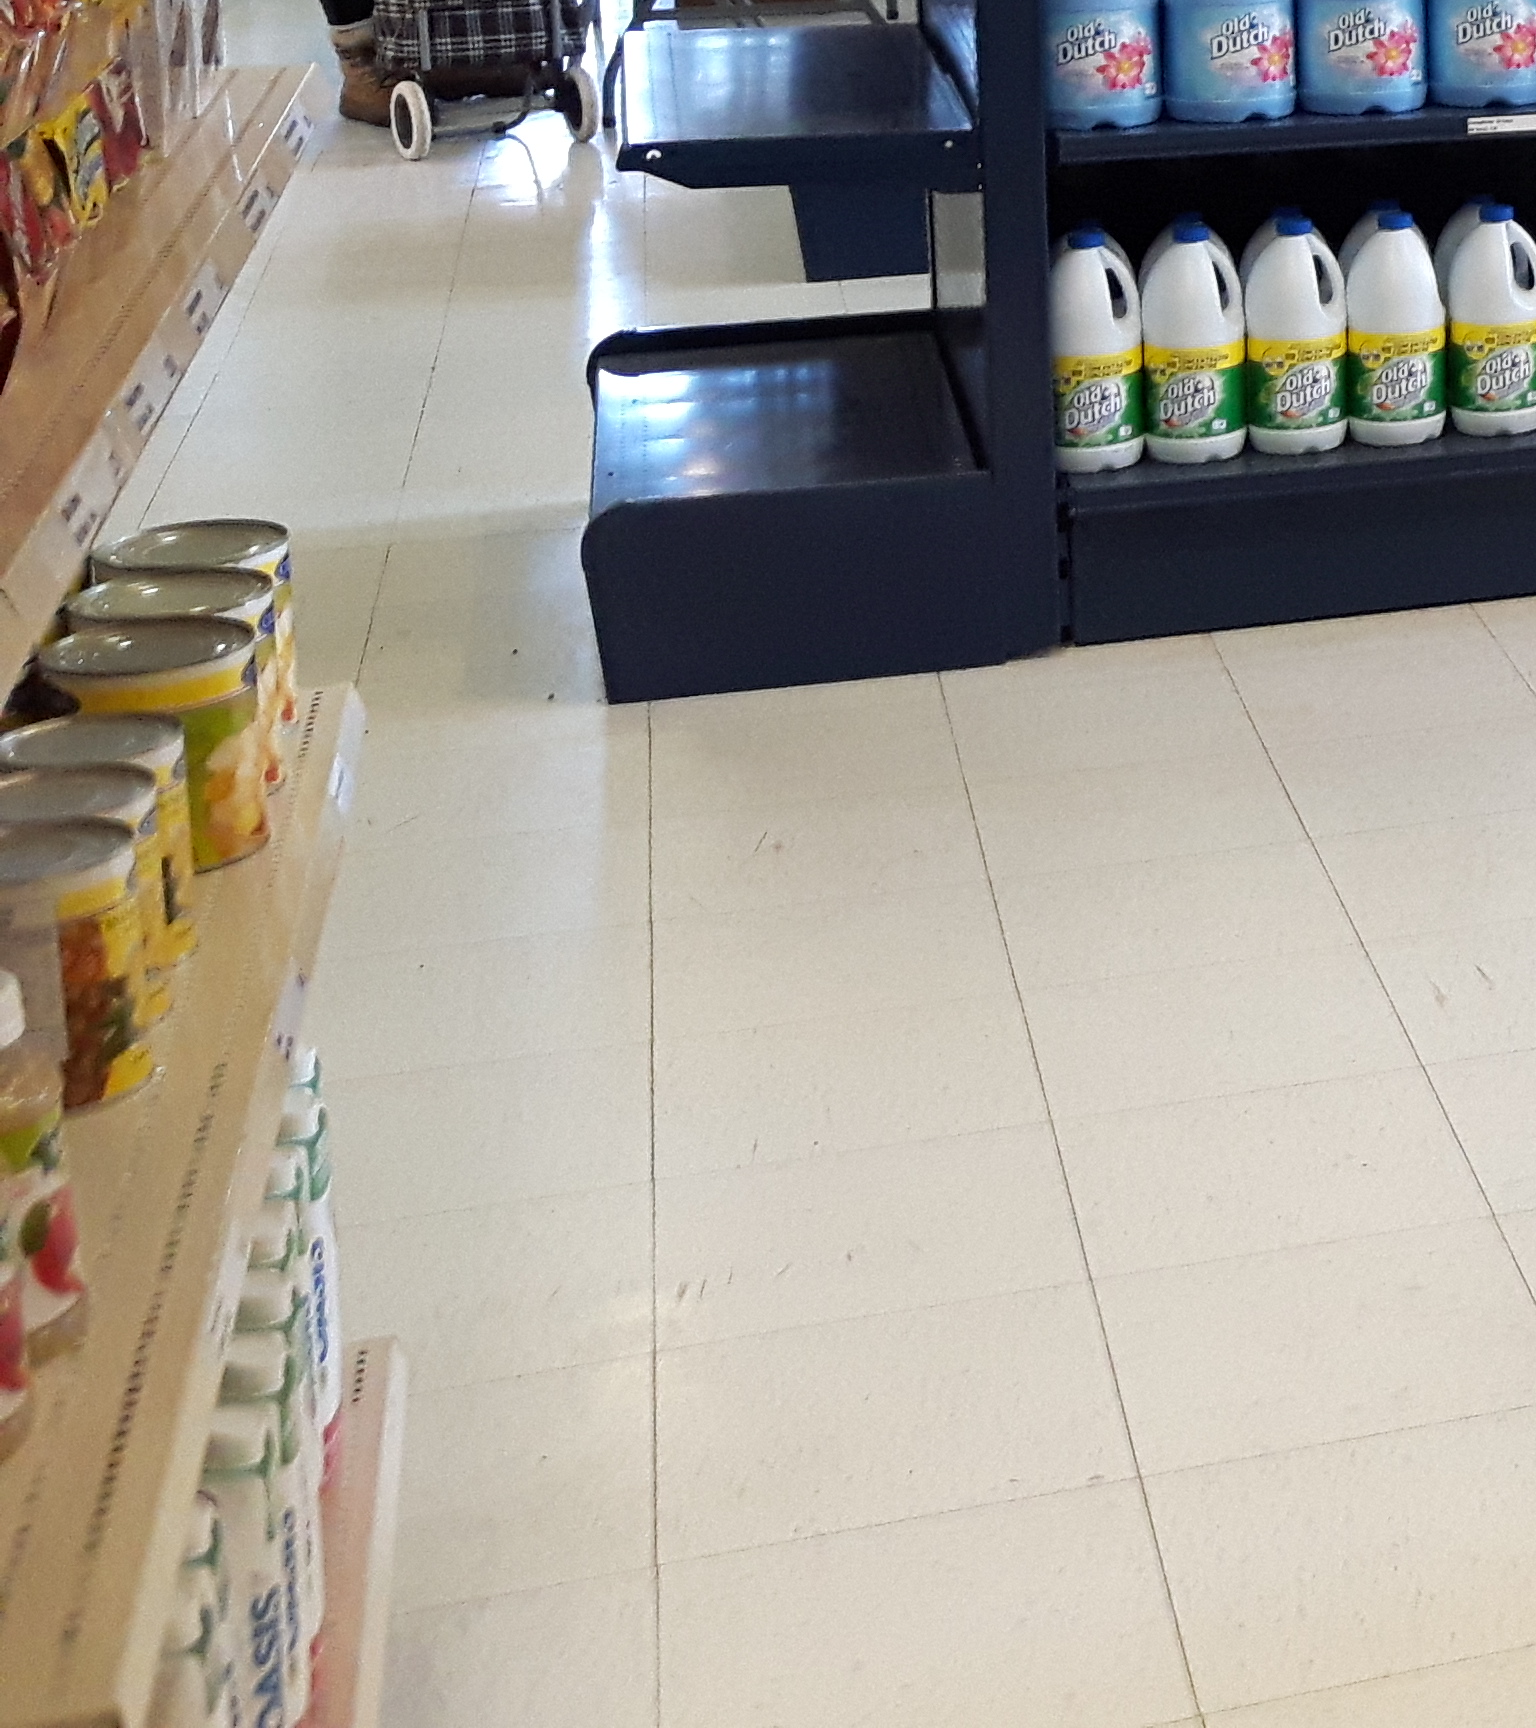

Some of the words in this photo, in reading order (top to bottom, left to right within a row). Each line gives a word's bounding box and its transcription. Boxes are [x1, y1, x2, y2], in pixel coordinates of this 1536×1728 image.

[1220, 15, 1252, 37] Old
[1338, 8, 1369, 30] Old
[1466, 2, 1497, 23] Old
[1065, 22, 1098, 43] Old
[1328, 18, 1387, 52] Dutch
[1456, 12, 1514, 45] Dutch
[1056, 31, 1117, 65] Dutch
[1210, 25, 1269, 61] Dutch
[1380, 363, 1412, 384] Old
[1484, 352, 1513, 374] Old
[1167, 377, 1197, 400] Old
[1284, 369, 1316, 391] Old
[1371, 372, 1428, 405] Dutch
[1476, 361, 1531, 394] Dutch
[1074, 387, 1102, 408] Old
[1158, 385, 1217, 420] Dutch
[1275, 378, 1331, 413] Dutch
[1064, 395, 1123, 429] Dutch
